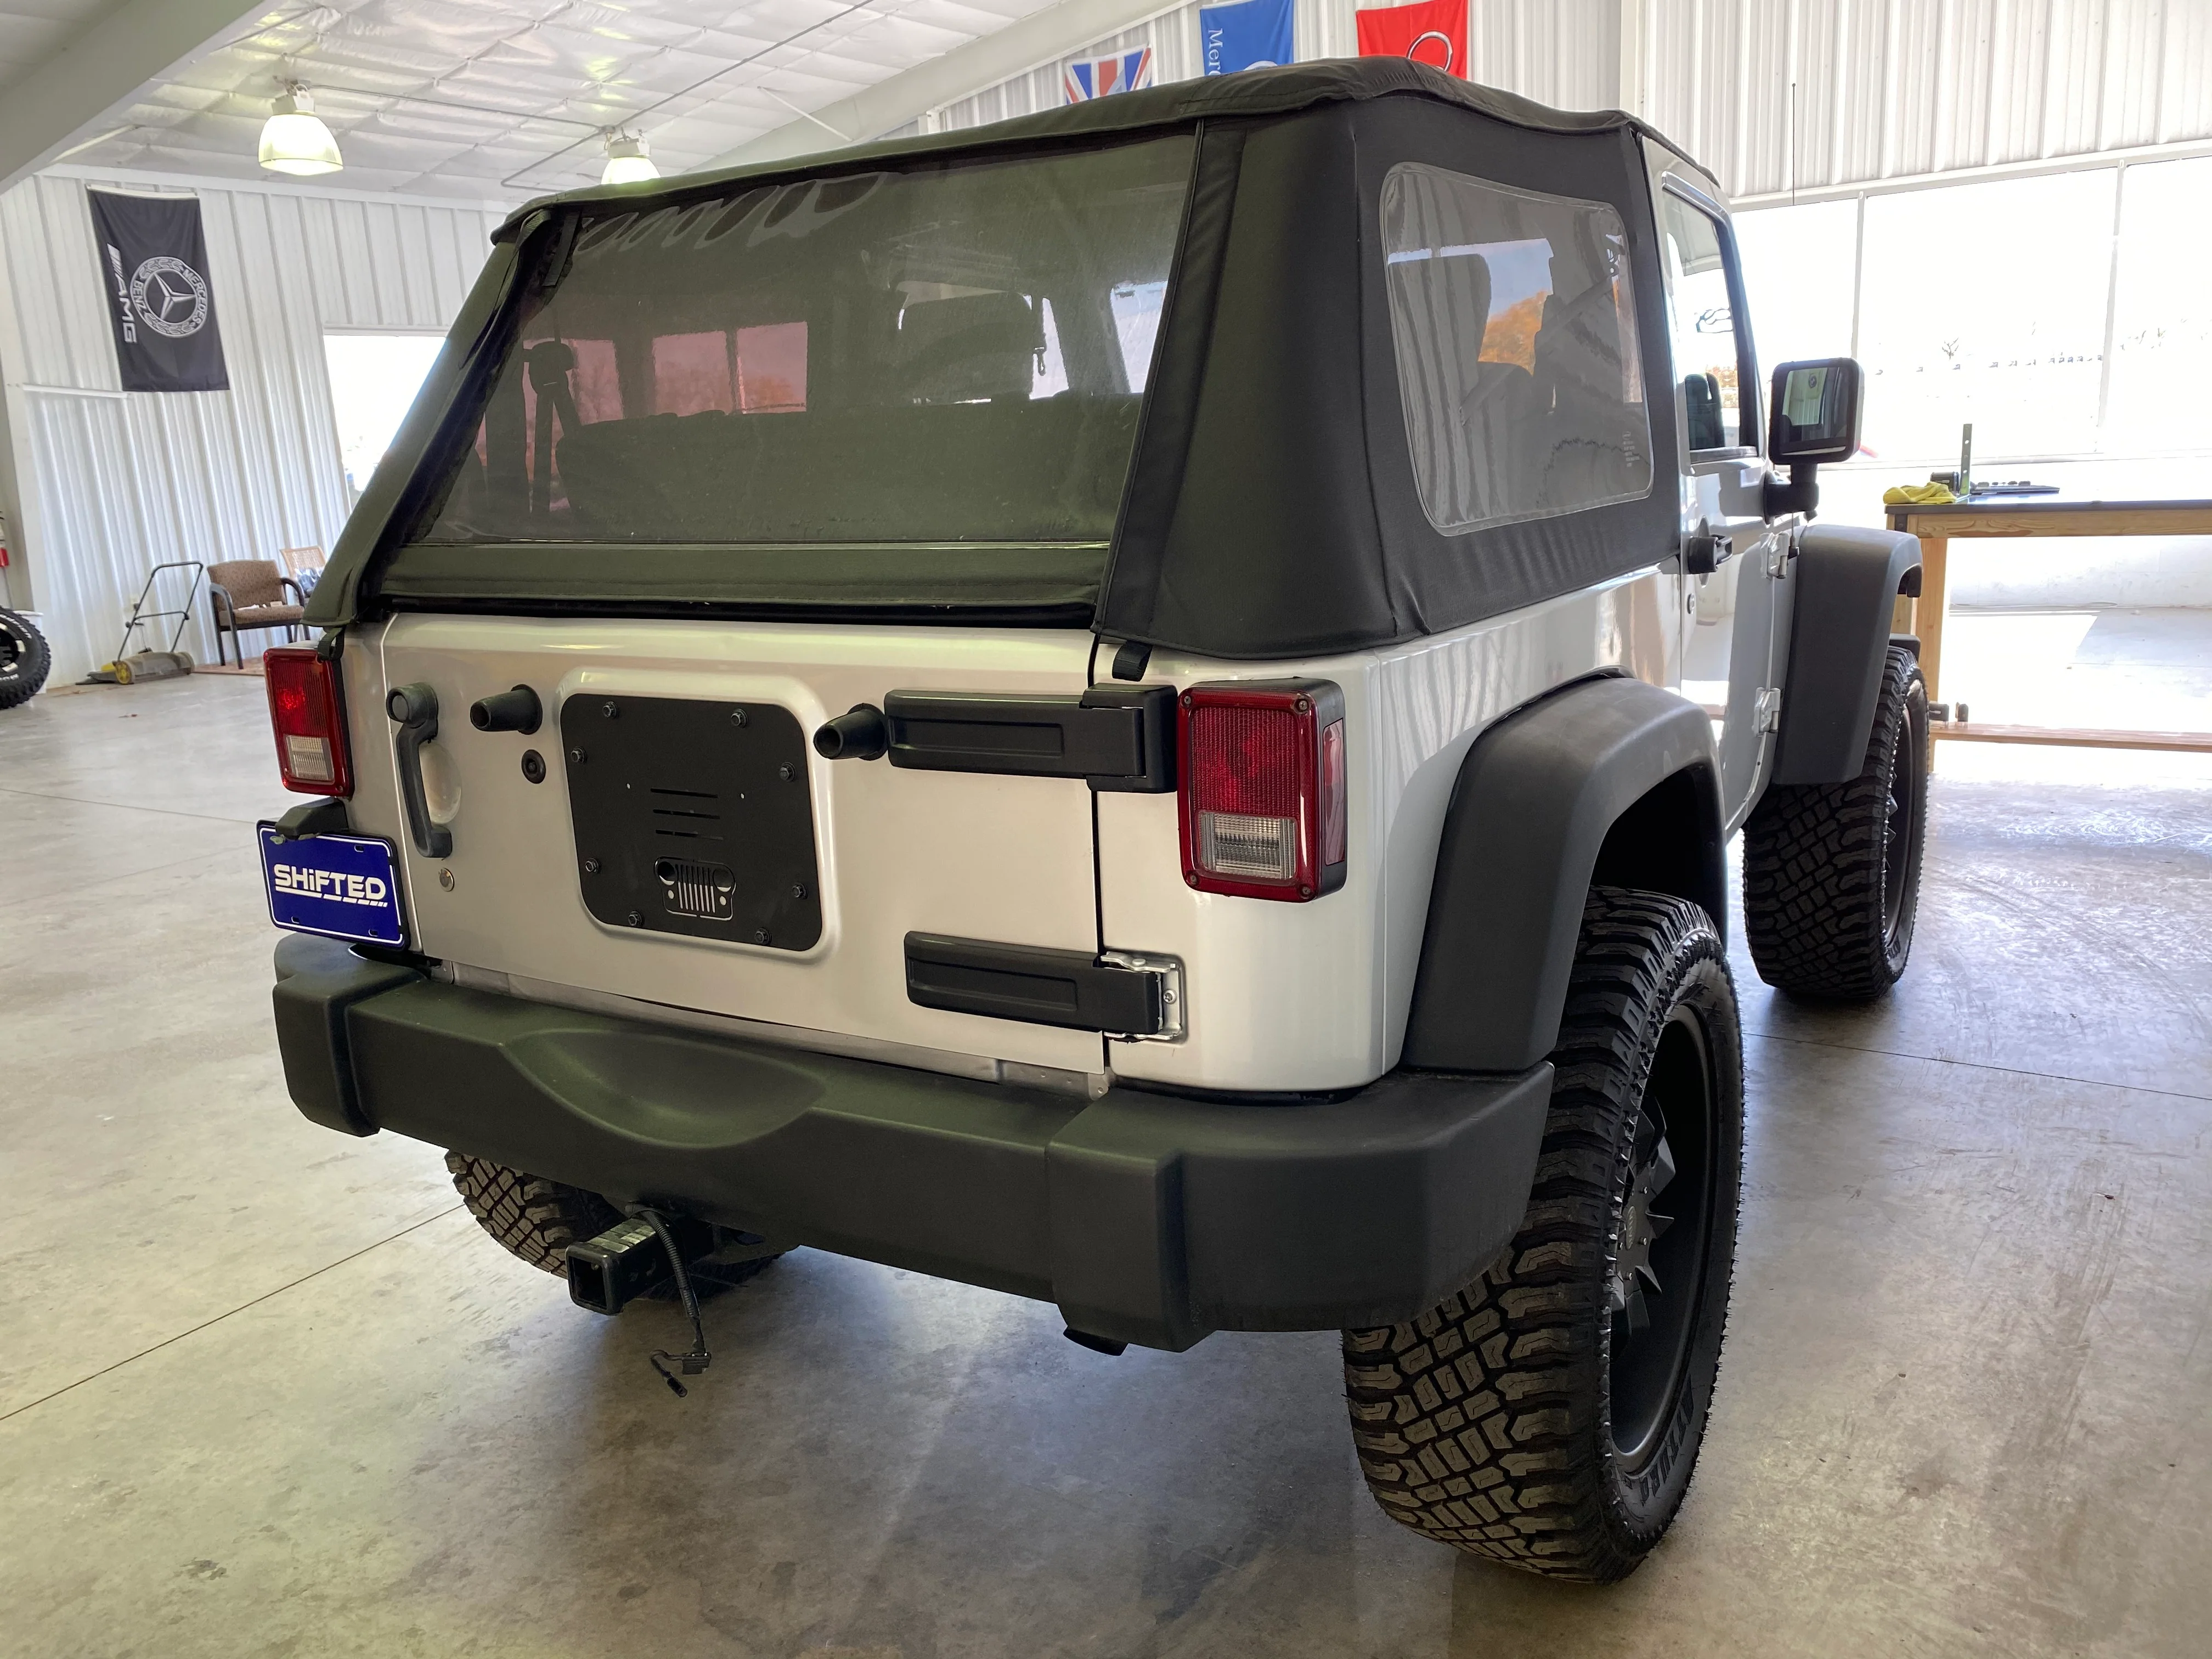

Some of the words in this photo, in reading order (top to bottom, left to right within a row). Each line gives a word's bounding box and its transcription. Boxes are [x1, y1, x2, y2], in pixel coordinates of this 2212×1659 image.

[114, 272, 137, 343] AMG
[133, 280, 147, 311] BENZ
[182, 269, 206, 325] MERCEDES
